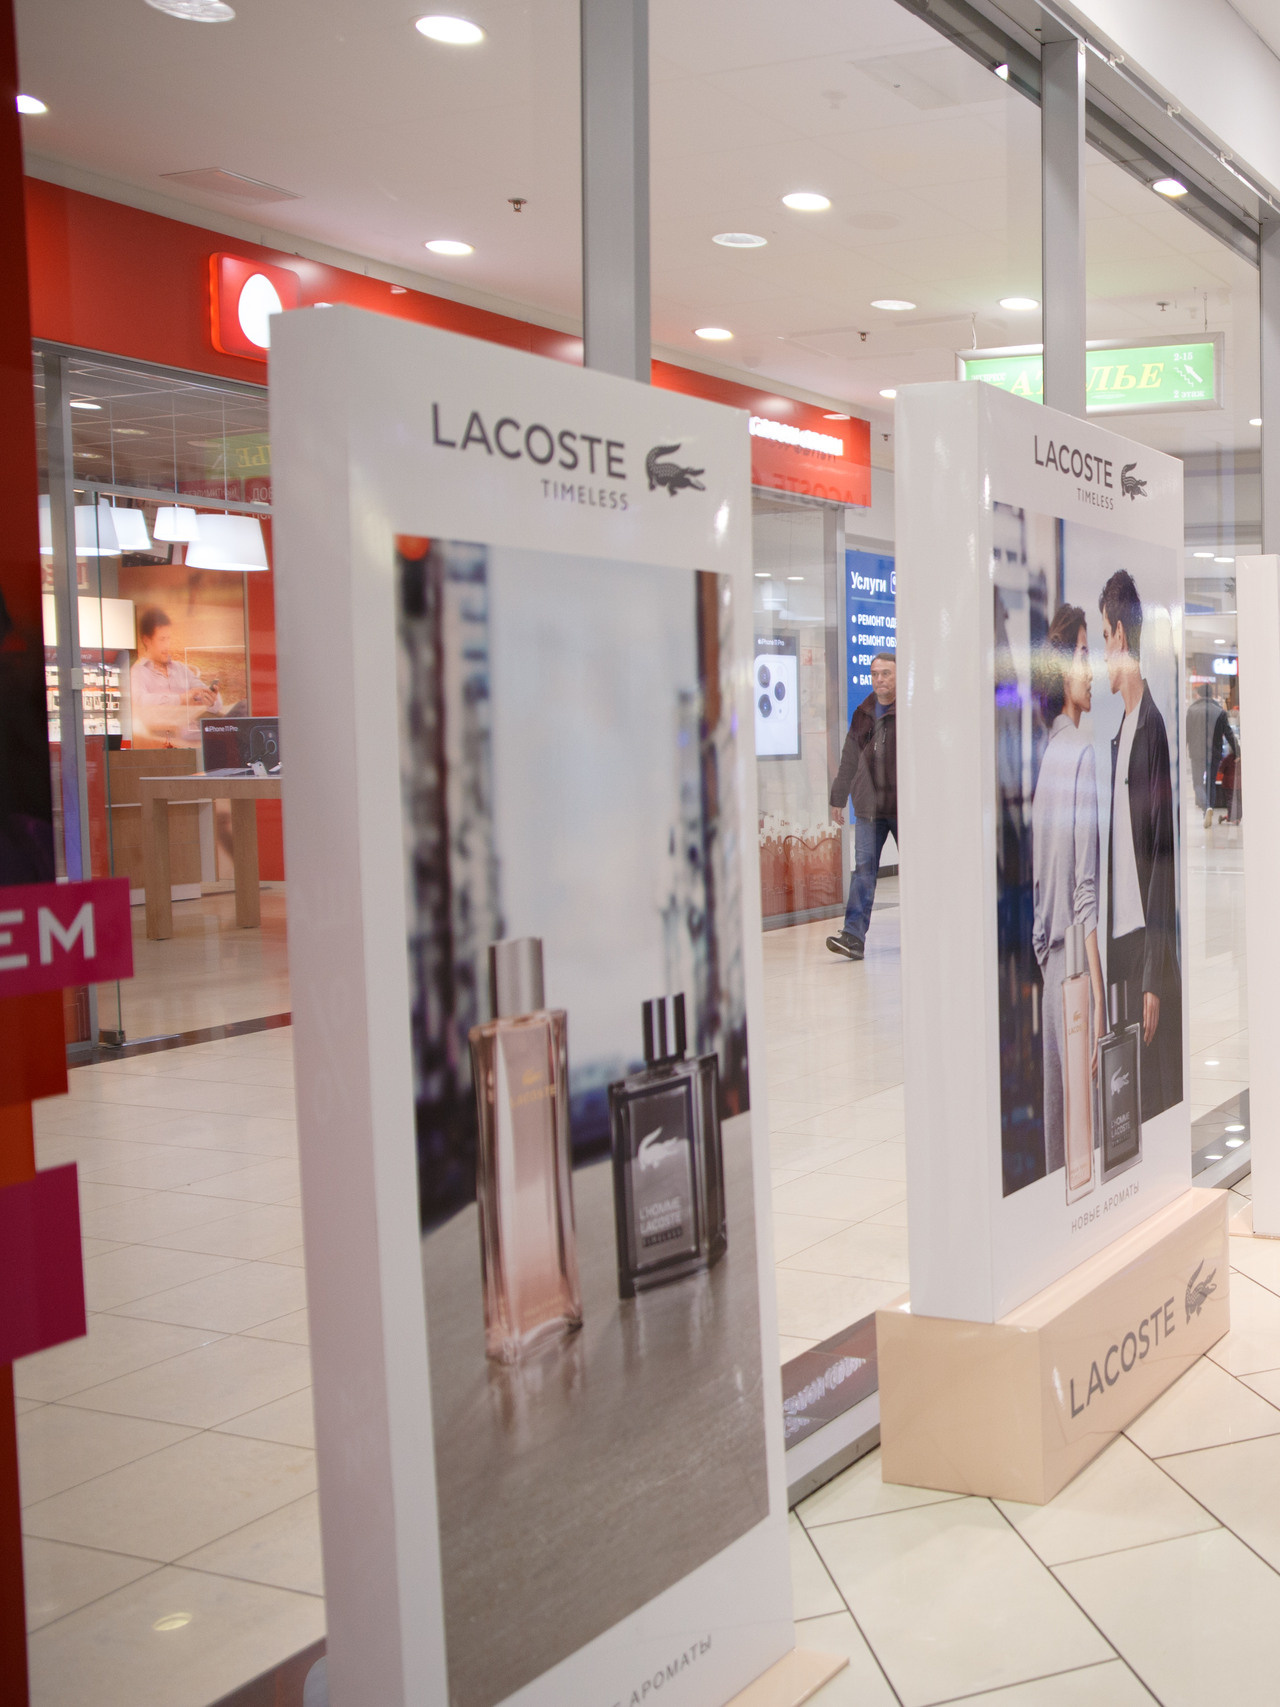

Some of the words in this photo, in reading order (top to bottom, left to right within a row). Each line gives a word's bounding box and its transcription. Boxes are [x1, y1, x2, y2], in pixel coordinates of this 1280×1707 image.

[432, 402, 627, 480] LACOSTE
[1034, 435, 1113, 488] LACOSTE
[541, 478, 629, 511] TIMELESS
[1077, 488, 1114, 510] TIMELESS
[851, 571, 887, 595] Услуги
[858, 614, 884, 627] РЕМОНТ
[858, 634, 885, 647] РЕМОНТ
[1072, 1204, 1100, 1234] НОВЫЕ
[1103, 1180, 1140, 1214] АРОМАТЫ
[1070, 1296, 1175, 1419] LACOSTE
[629, 1633, 712, 1707] АРОМАТЫ
